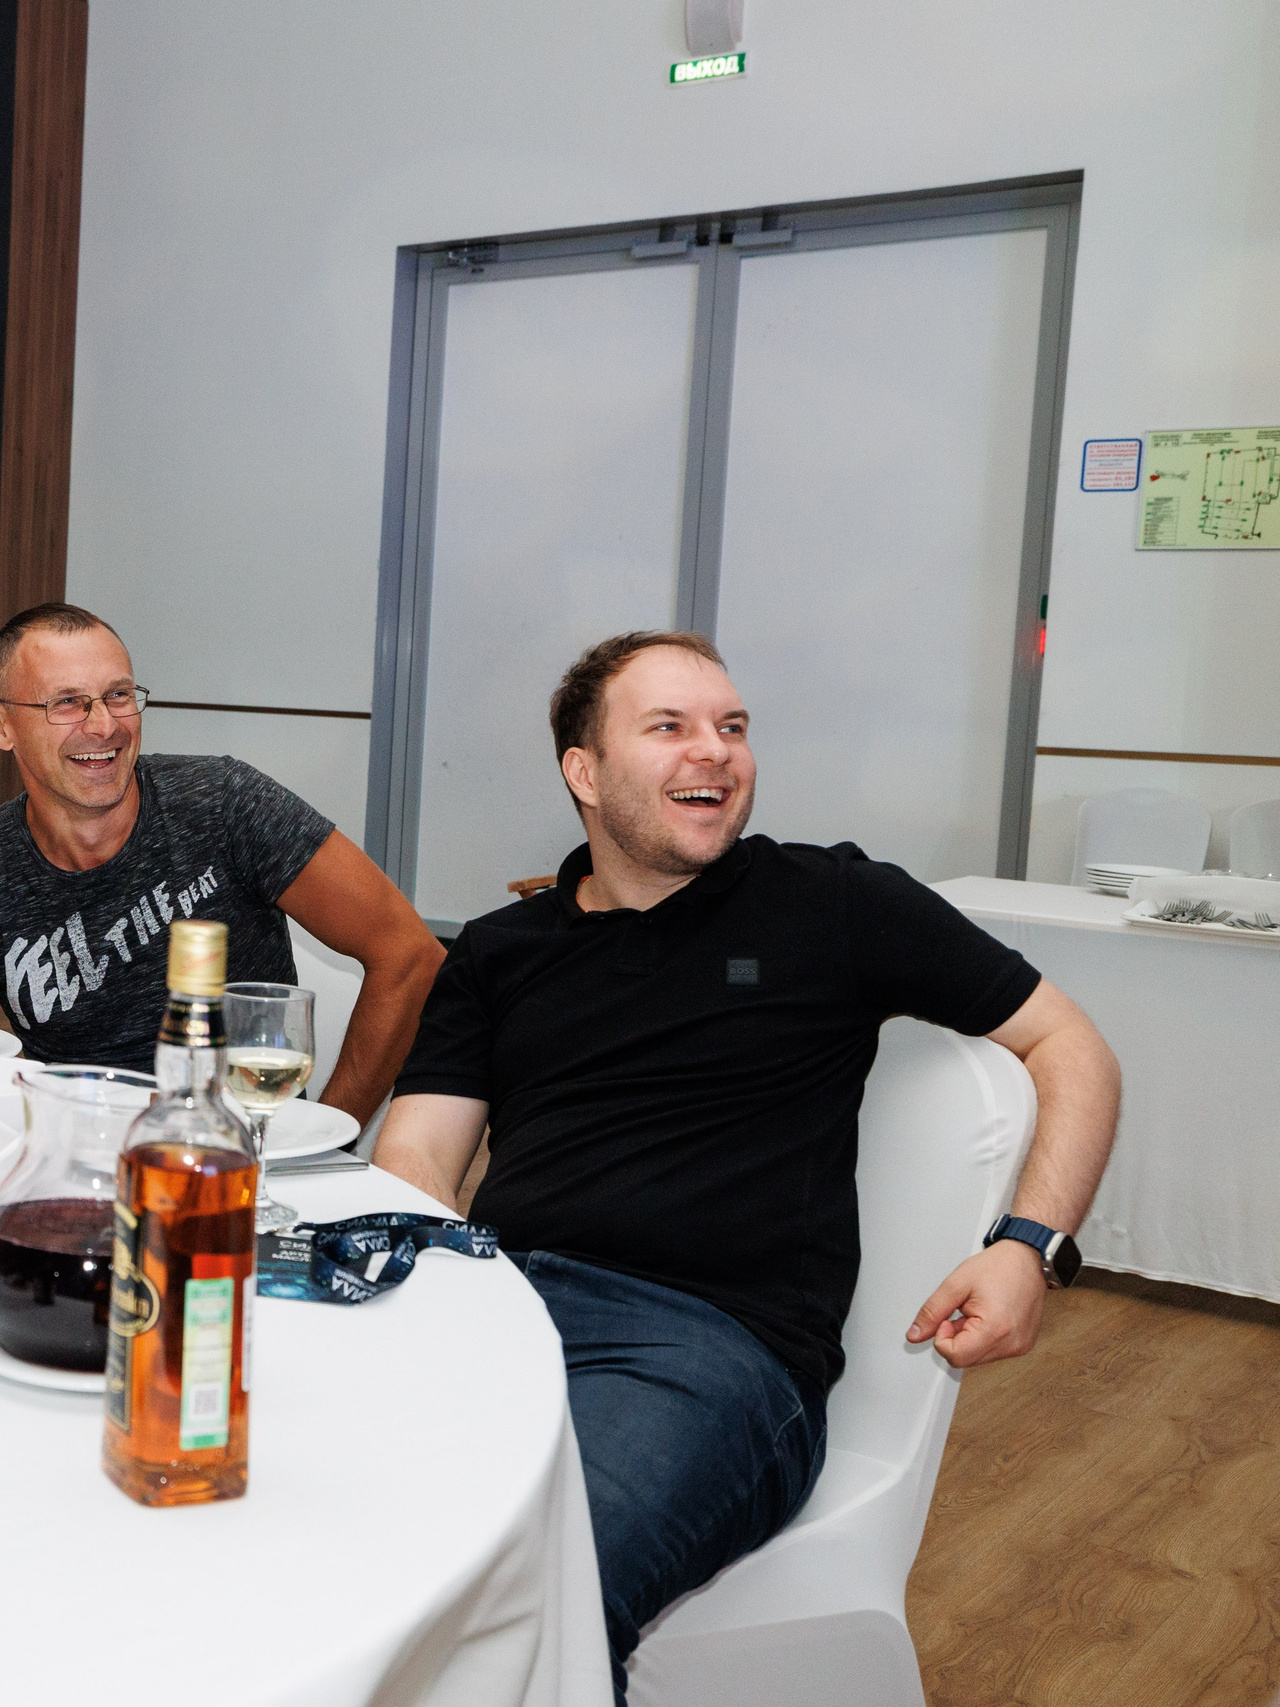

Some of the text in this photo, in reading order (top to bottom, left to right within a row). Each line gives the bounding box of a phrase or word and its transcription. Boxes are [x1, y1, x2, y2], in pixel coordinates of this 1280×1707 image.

[675, 56, 740, 82] ВЫХОД
[4, 865, 219, 1030] FEEL THE BEAT
